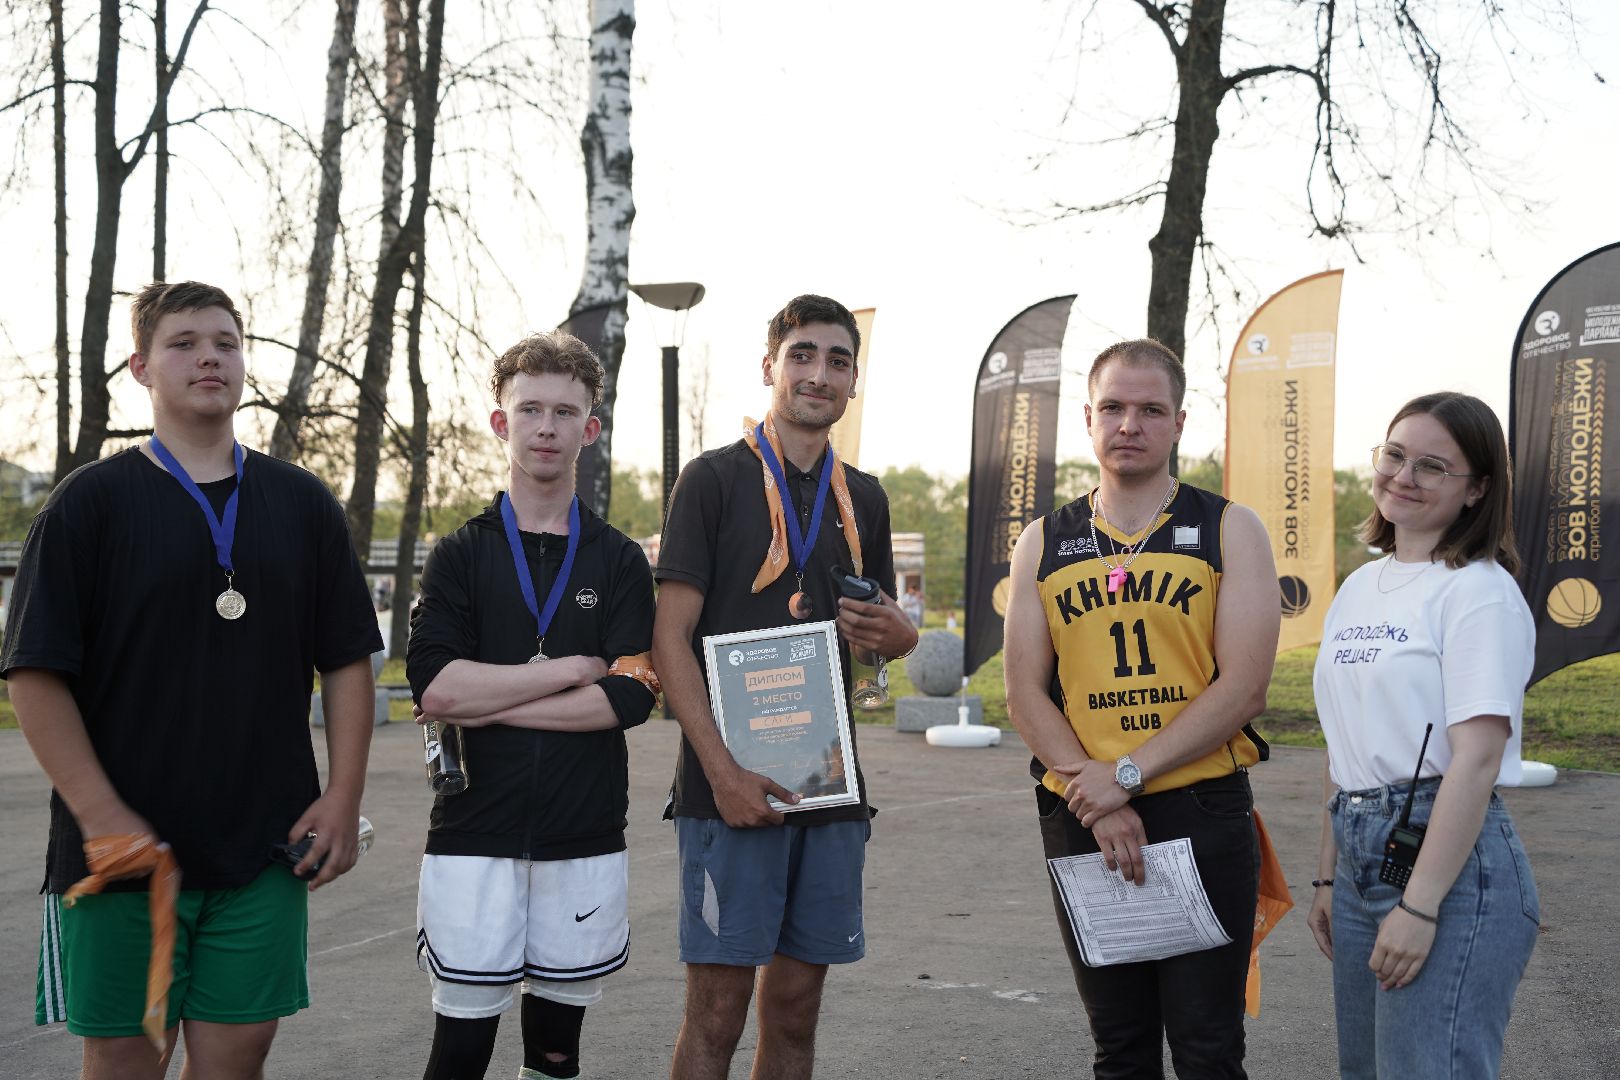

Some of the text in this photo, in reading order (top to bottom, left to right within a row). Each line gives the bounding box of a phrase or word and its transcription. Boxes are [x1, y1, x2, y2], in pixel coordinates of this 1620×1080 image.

[1008, 392, 1031, 518] МОЛОДЁЖИ
[1281, 380, 1300, 559] ЗОВ МОЛОДЁЖИ
[1568, 357, 1594, 561] ЗОВ МОЛОДЁЖИ
[1590, 500, 1602, 561] стритбол
[1055, 570, 1203, 625] KHIMIK
[1109, 618, 1157, 678] 11
[1333, 648, 1382, 665] РЕШАЕТ
[748, 671, 802, 687] ДИПЛОМ
[752, 691, 803, 706] 2 МЕСТО
[1088, 685, 1188, 710] BASKETBALL
[1120, 713, 1162, 732] CLUB
